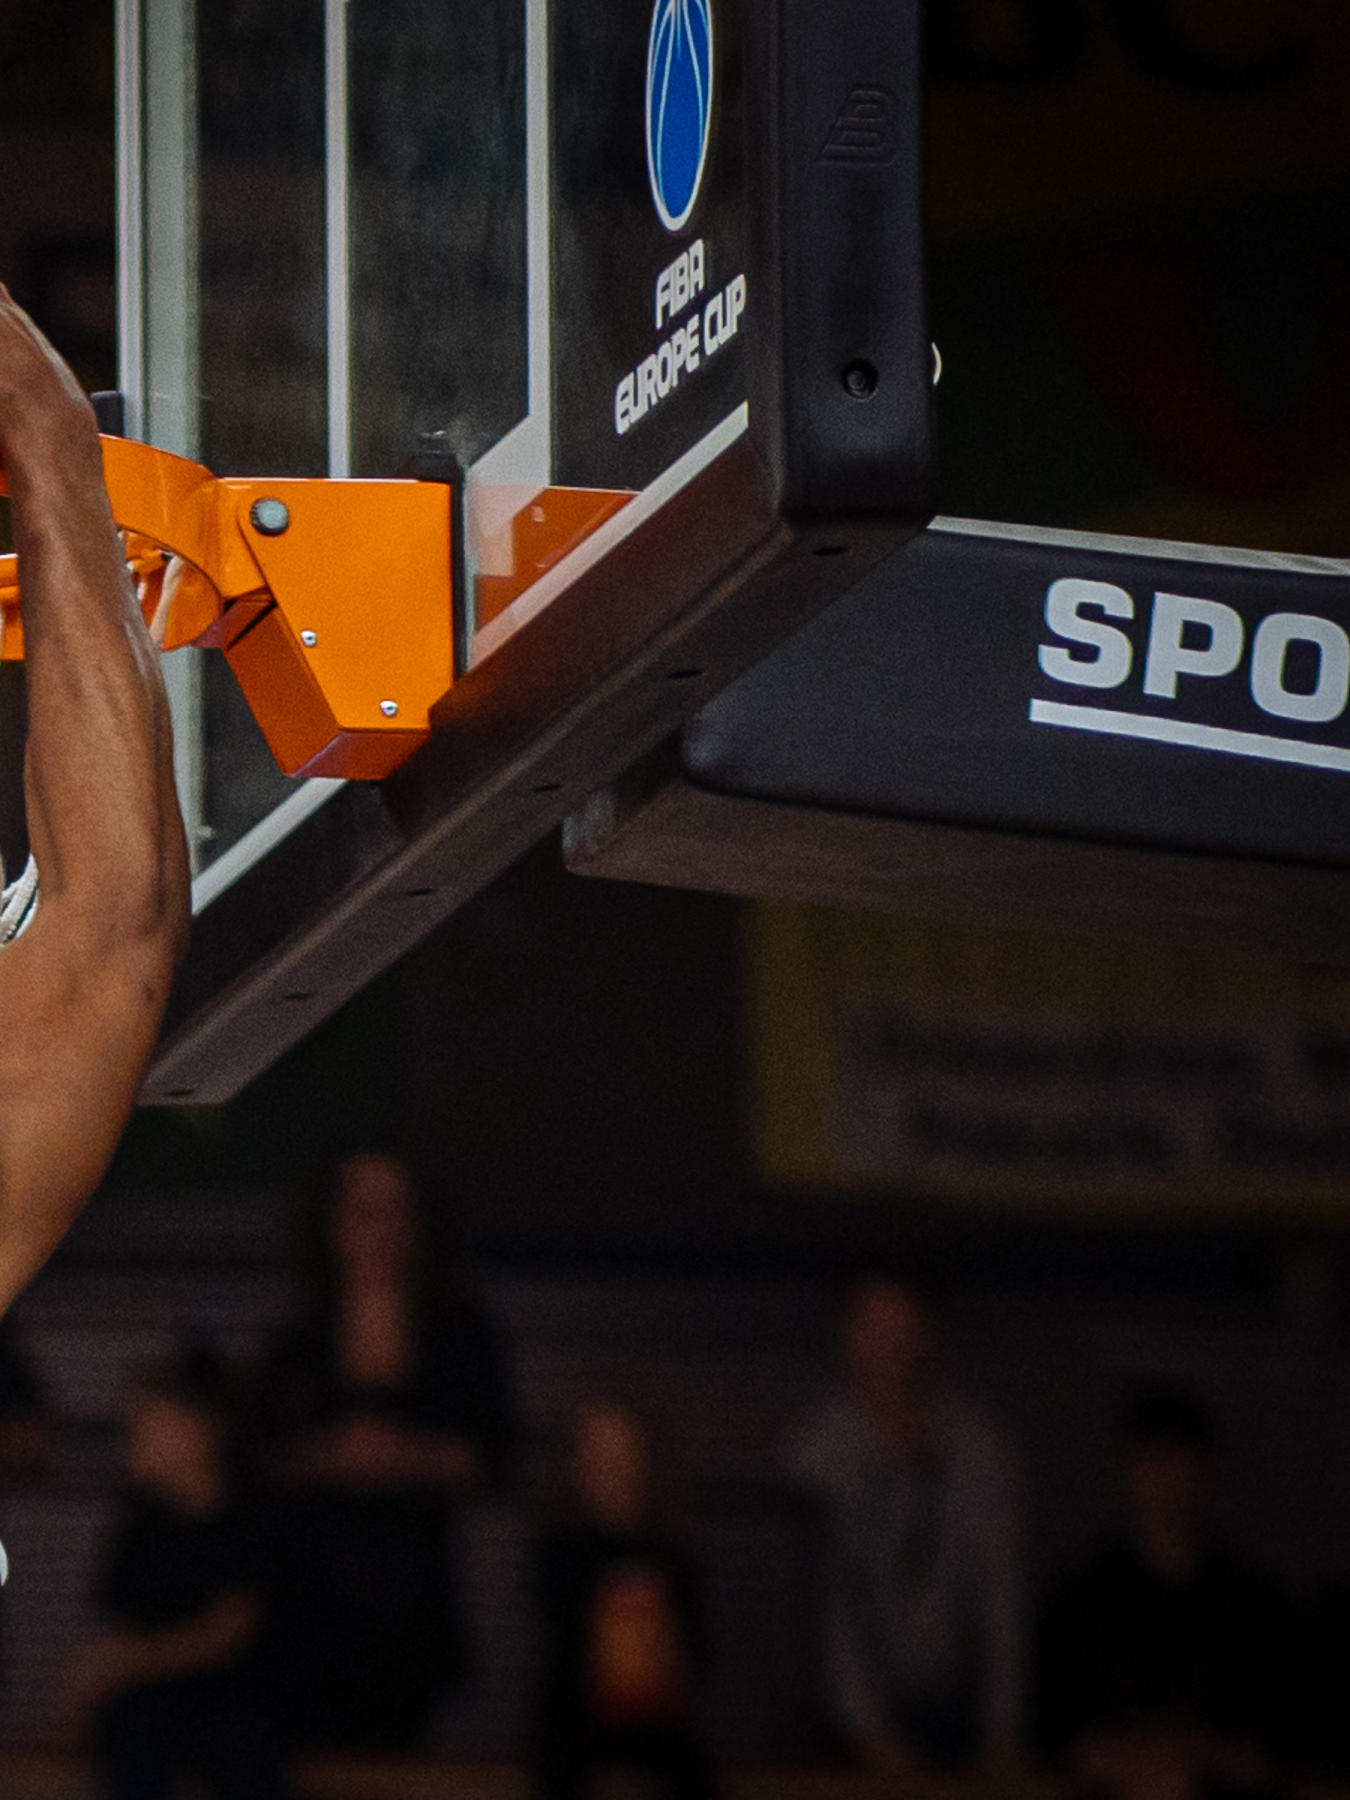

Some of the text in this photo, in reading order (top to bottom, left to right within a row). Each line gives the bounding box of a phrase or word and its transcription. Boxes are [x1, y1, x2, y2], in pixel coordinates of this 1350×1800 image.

[615, 273, 746, 435] EUROPE CUP
[656, 238, 705, 330] FIBA
[1037, 577, 1350, 723] SPO
